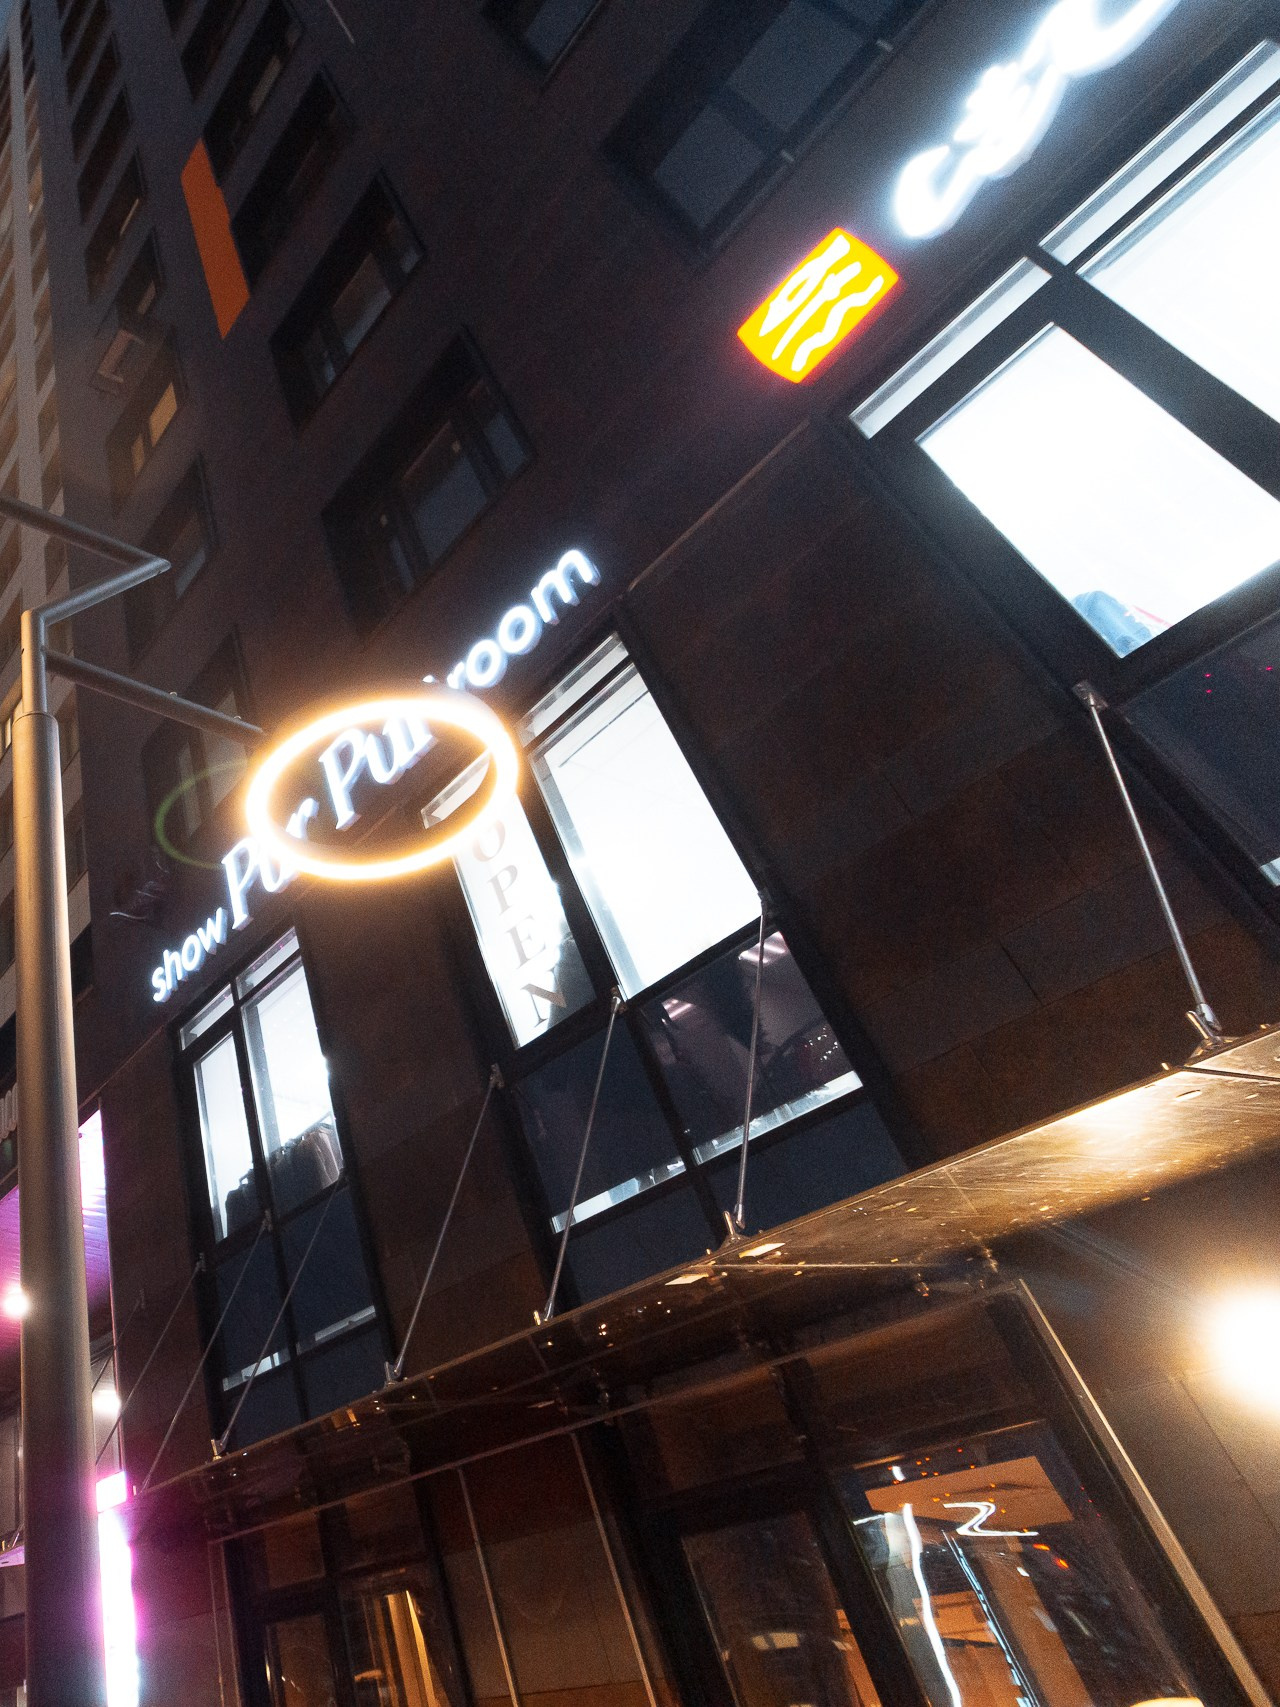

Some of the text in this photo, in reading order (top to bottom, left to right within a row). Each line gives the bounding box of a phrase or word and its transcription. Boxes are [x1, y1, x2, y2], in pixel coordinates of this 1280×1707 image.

[151, 906, 227, 1002] show
[446, 549, 601, 690] room
[472, 819, 568, 1029] OPEN
